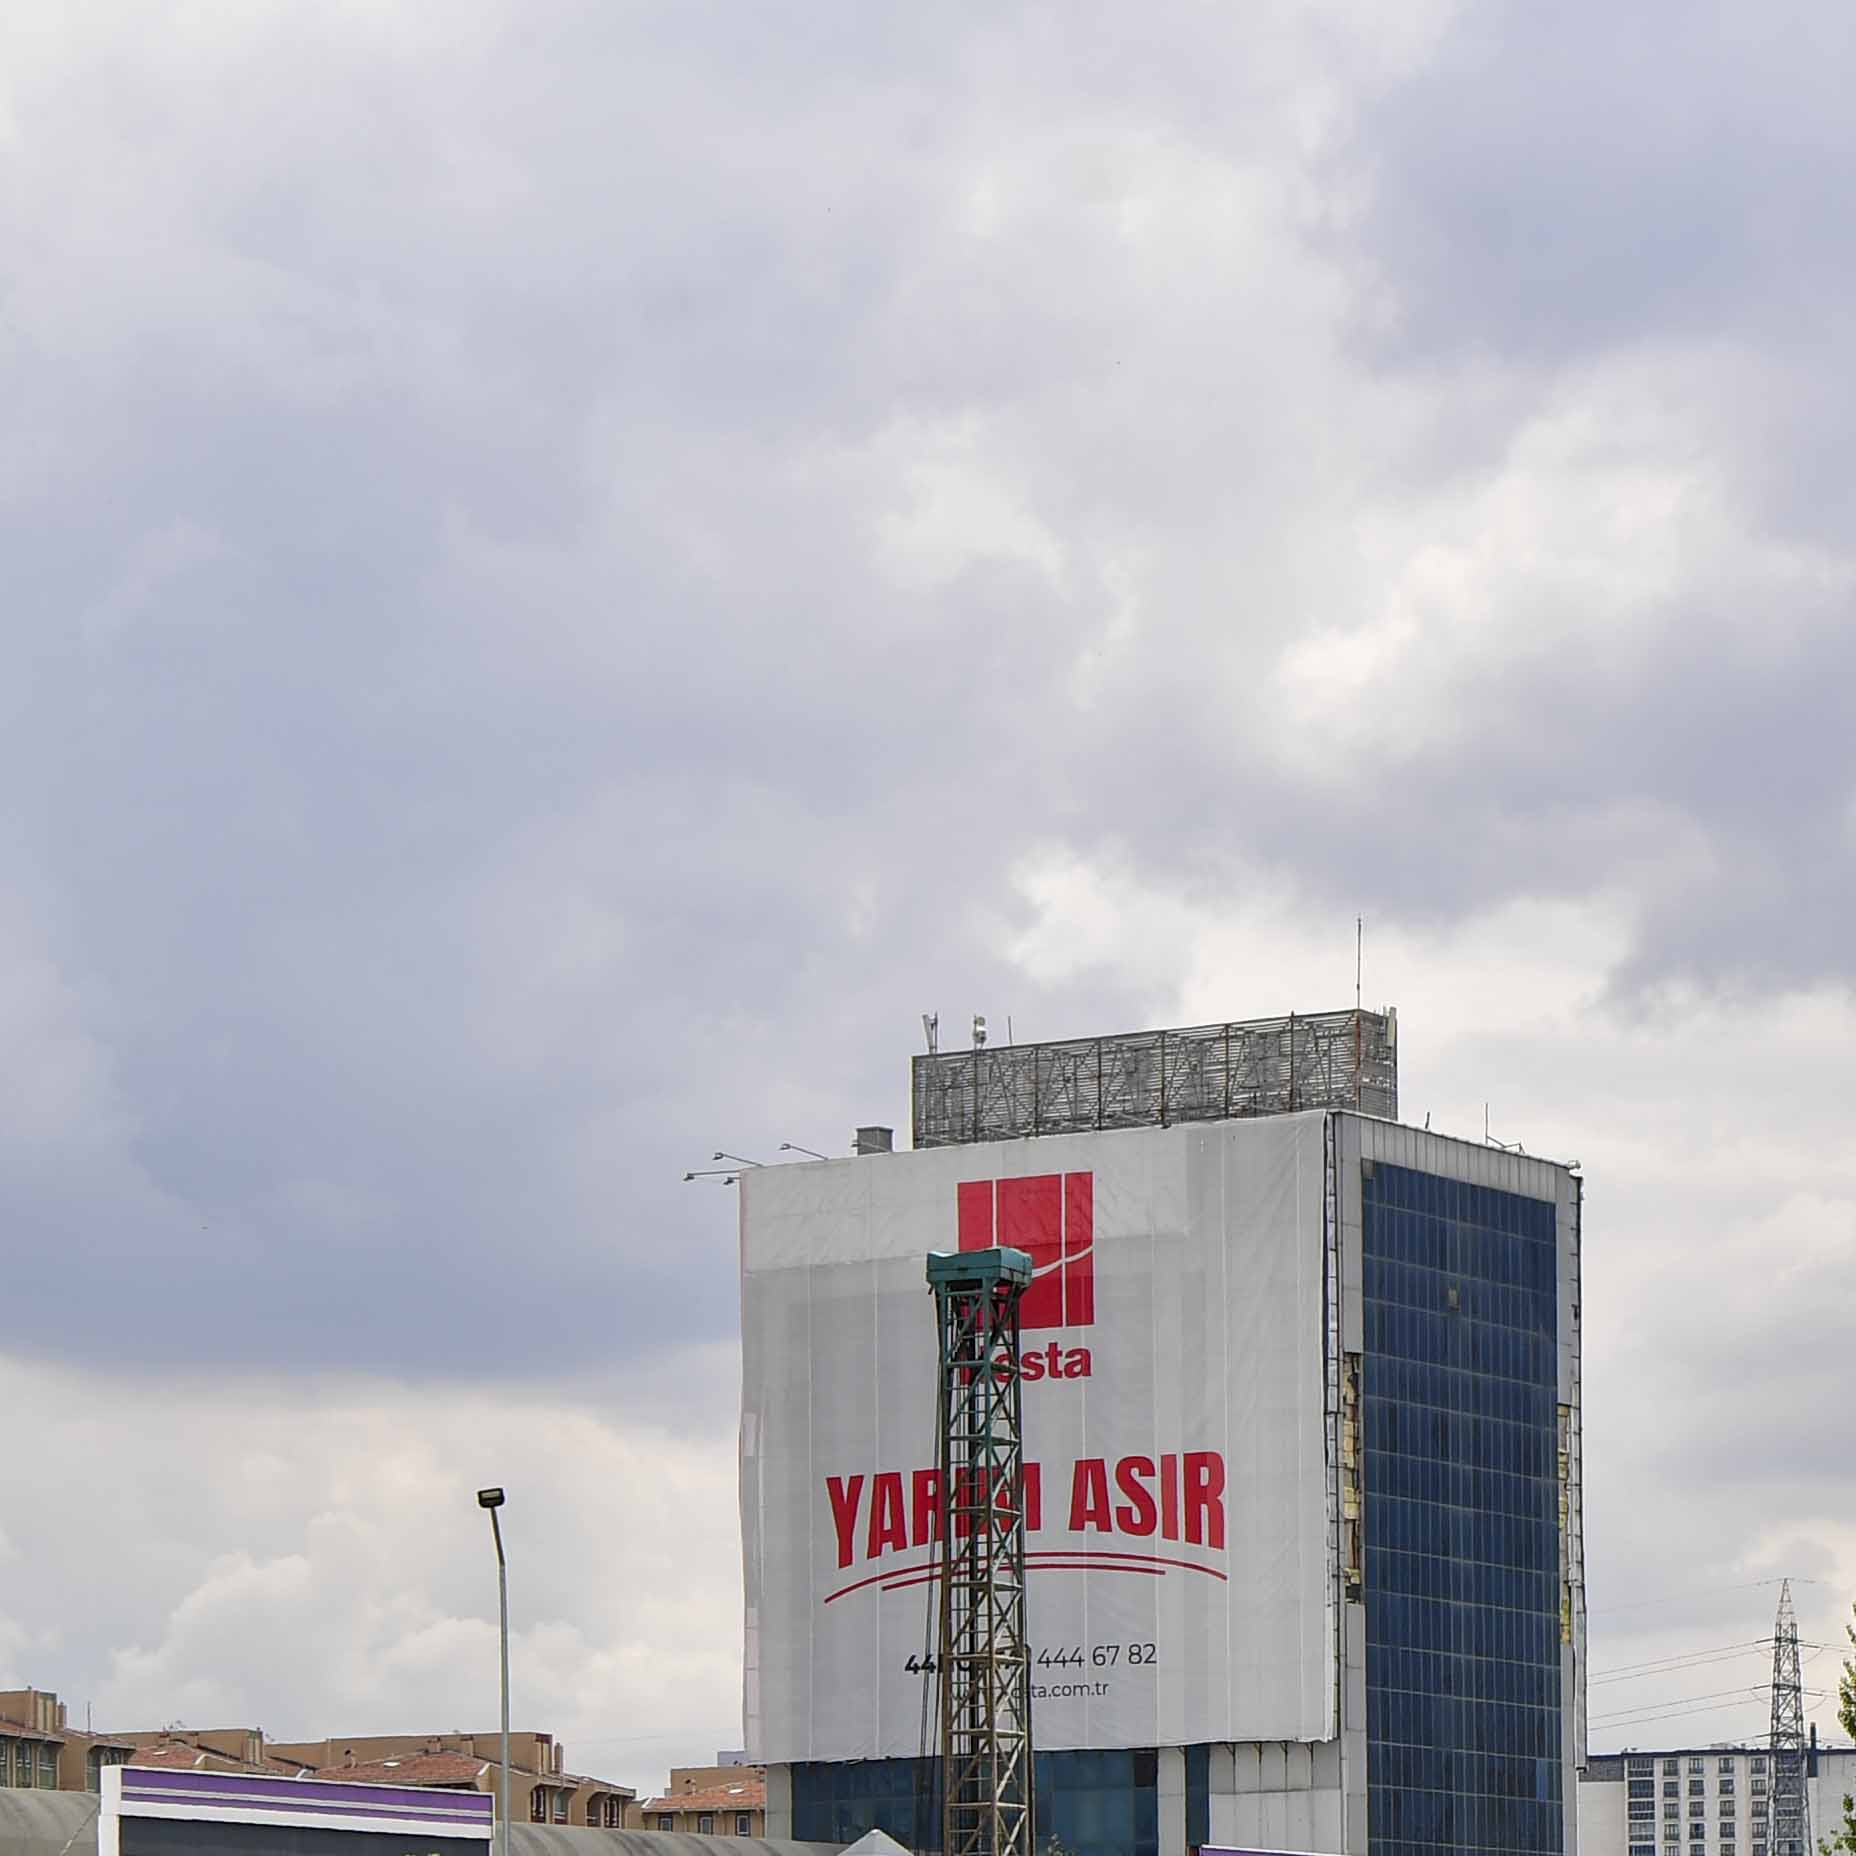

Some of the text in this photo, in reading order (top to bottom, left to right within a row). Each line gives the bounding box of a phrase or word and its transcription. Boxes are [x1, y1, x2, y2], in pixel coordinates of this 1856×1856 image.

[1068, 1450, 1225, 1550] ASIR
[1036, 1647, 1085, 1669] 444
[1092, 1645, 1120, 1667] 67
[1128, 1643, 1157, 1665] 82
